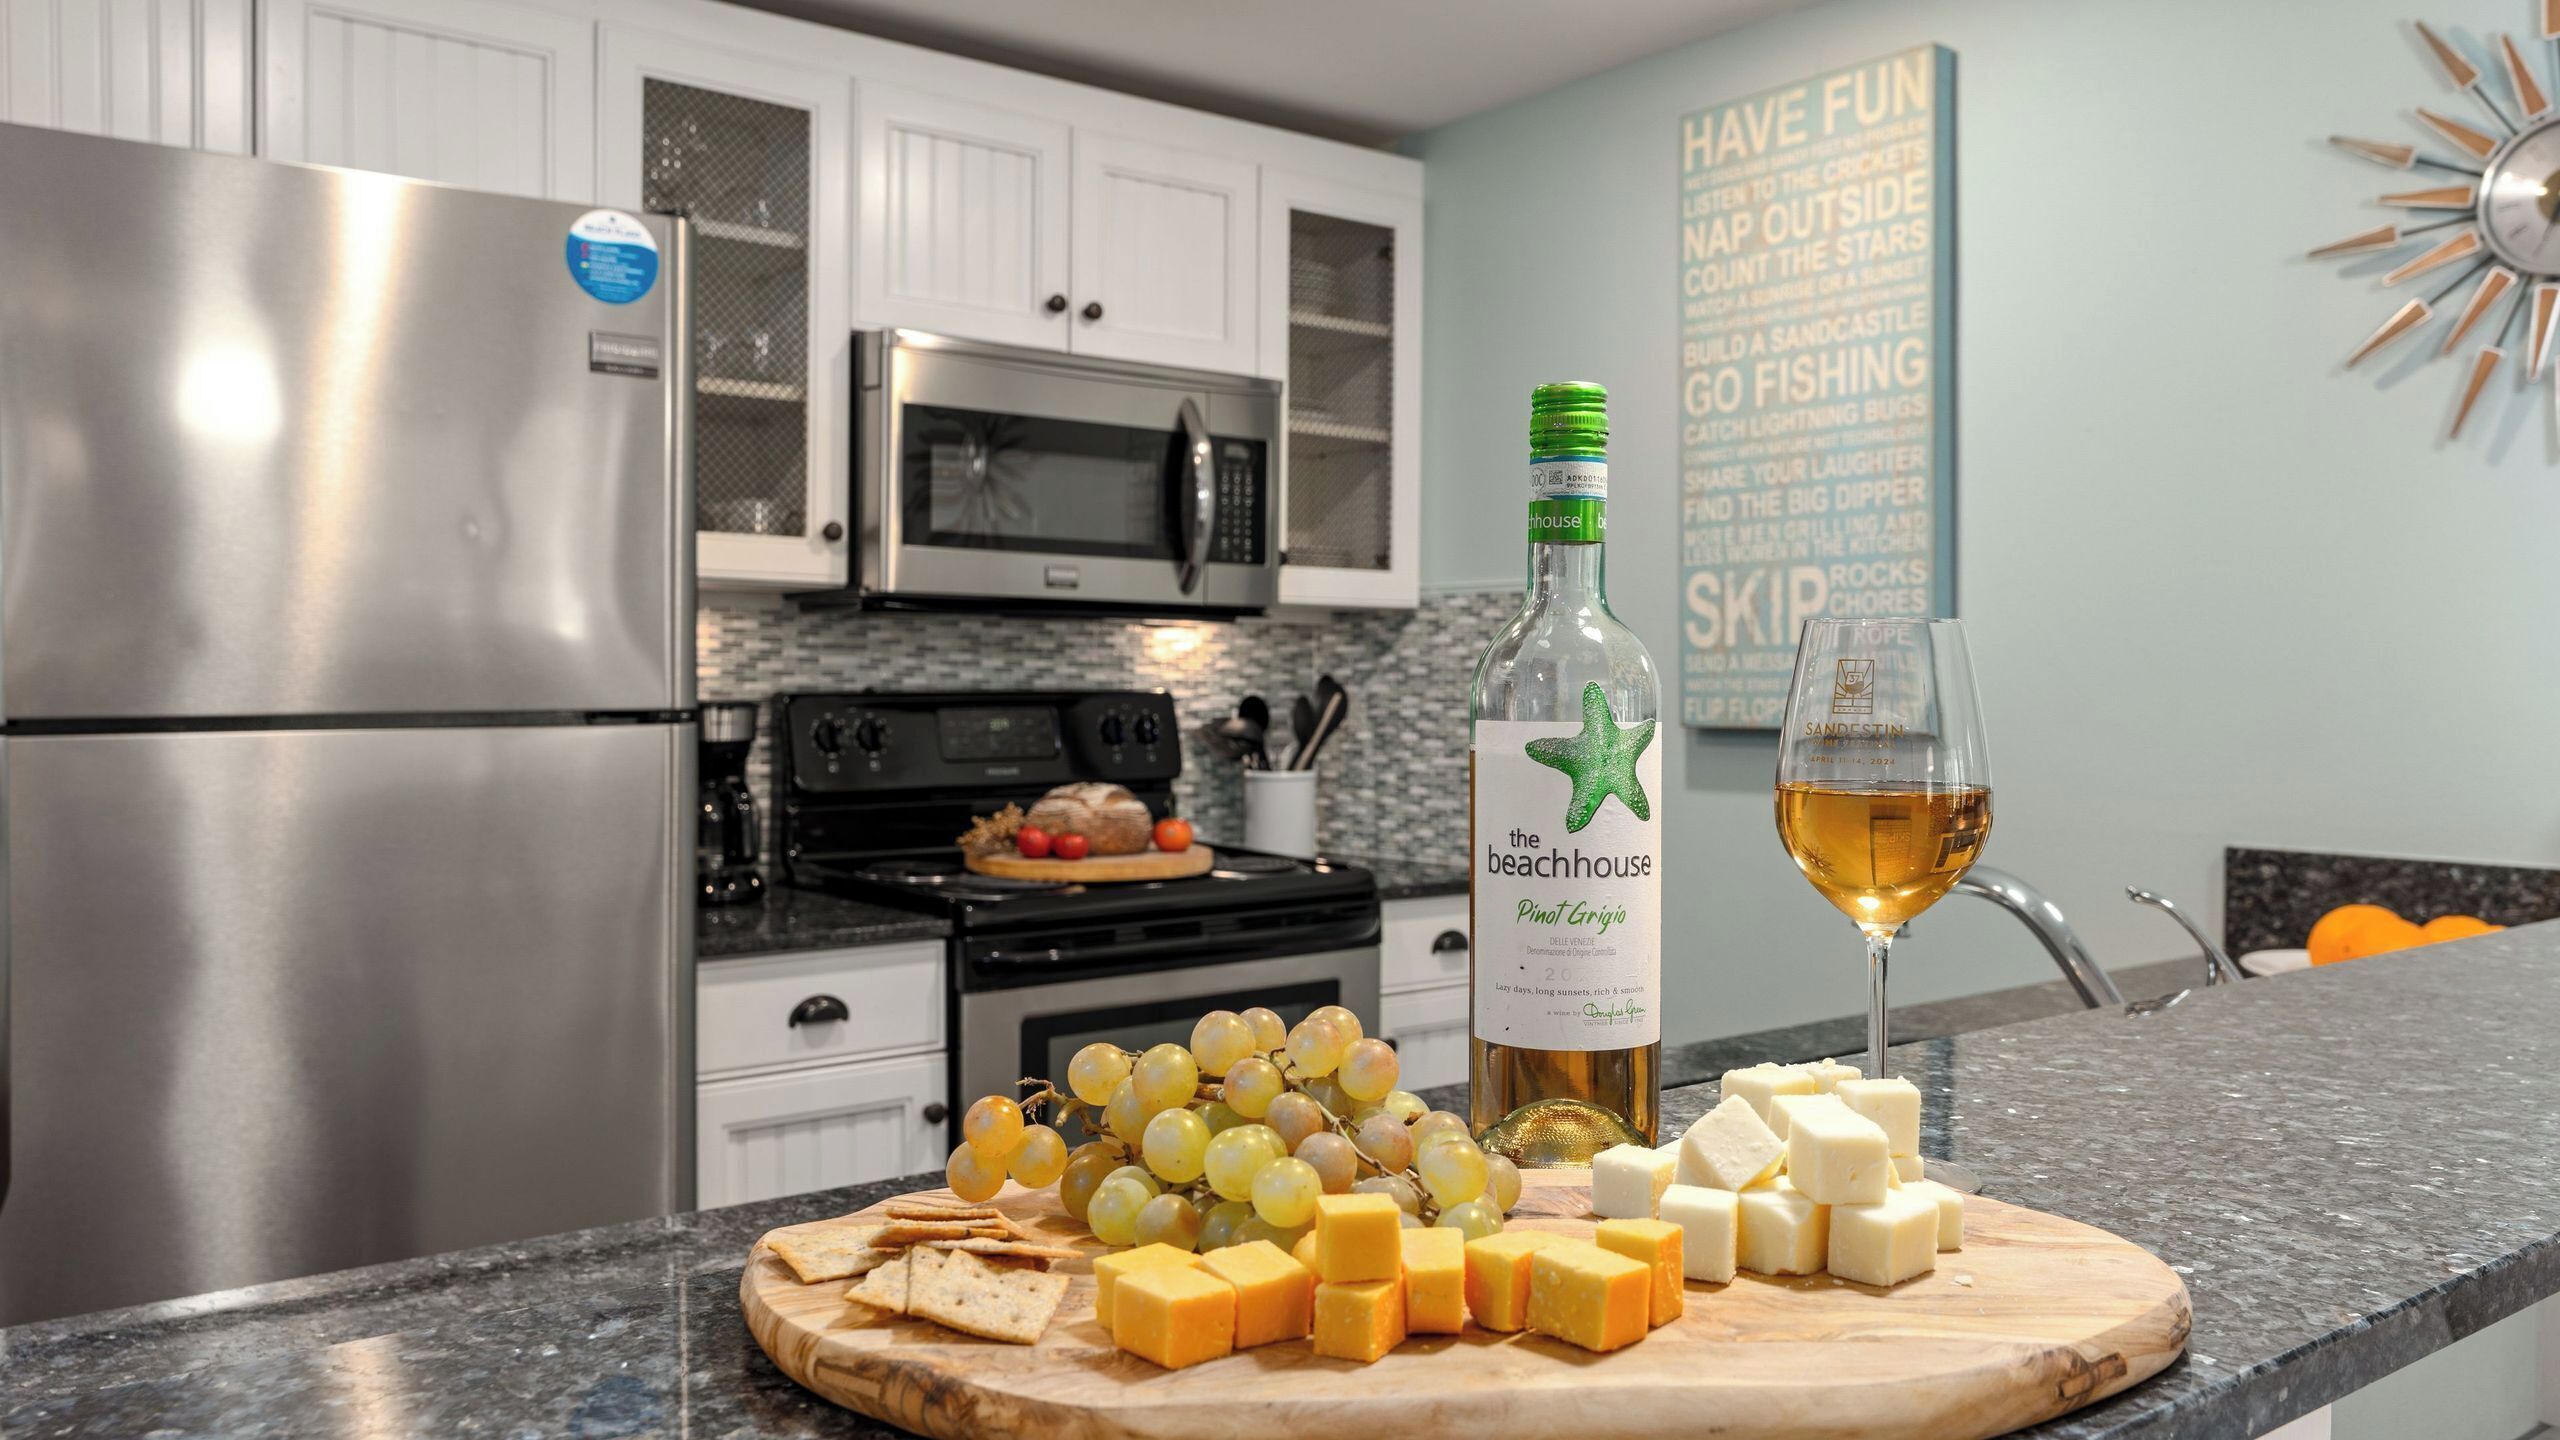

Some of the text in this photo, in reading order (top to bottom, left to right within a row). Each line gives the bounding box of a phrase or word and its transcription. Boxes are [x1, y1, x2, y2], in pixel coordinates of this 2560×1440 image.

[1684, 52, 1927, 172] HAVE FUN
[1684, 136, 1928, 219] LISTEN TO THE CRICKETS
[1684, 167, 1928, 264] NAP OUTSIDE
[1684, 251, 1768, 297] COUNT
[1776, 238, 1829, 279] THE
[1836, 217, 1928, 267] STARS
[1685, 292, 1734, 320] WATCH
[1736, 290, 1747, 310] A
[1749, 276, 1814, 308] SUNRISE
[1818, 271, 1840, 295] OR
[1844, 268, 1856, 290] A
[1861, 254, 1926, 287] SUNSET
[1684, 332, 1746, 368] BUILD
[1749, 329, 1765, 358] A
[1770, 300, 1927, 354] SANDCASTLE
[1684, 335, 1926, 419] GO FISHING
[1684, 390, 1926, 448] CATCH LIGHTNING BUGS
[1684, 442, 1925, 494] SHARE YOUR LAUGHTER
[1684, 473, 1925, 525] FIND THE BIG DIPPER
[1884, 507, 1927, 532] AND
[1813, 537, 1842, 557] THE
[1849, 530, 1928, 554] KITCHEN
[1828, 557, 1926, 589] ROCKS
[1685, 561, 1828, 649] SKIP
[1828, 586, 1926, 617] CHORES
[1853, 626, 1914, 647] ROPE
[1849, 674, 1860, 683] 37
[1685, 698, 1724, 721] FLIP
[1805, 722, 1905, 738] SANDESTIN
[1810, 755, 1834, 764] APRIL
[1871, 757, 1895, 765] 2024
[1509, 828, 1540, 849] the
[1488, 844, 1651, 878] beachhouse
[1516, 899, 1627, 935] Pinot Grigio
[1526, 946, 1617, 959] Denominazione di Origine Controllata
[1549, 937, 1595, 946] DELLE VENEZIE
[1495, 982, 1645, 997] Lazy days, long sunsets, rich & smooth
[1572, 1010, 1581, 1018] by
[1583, 1002, 1624, 1025] Douglas
